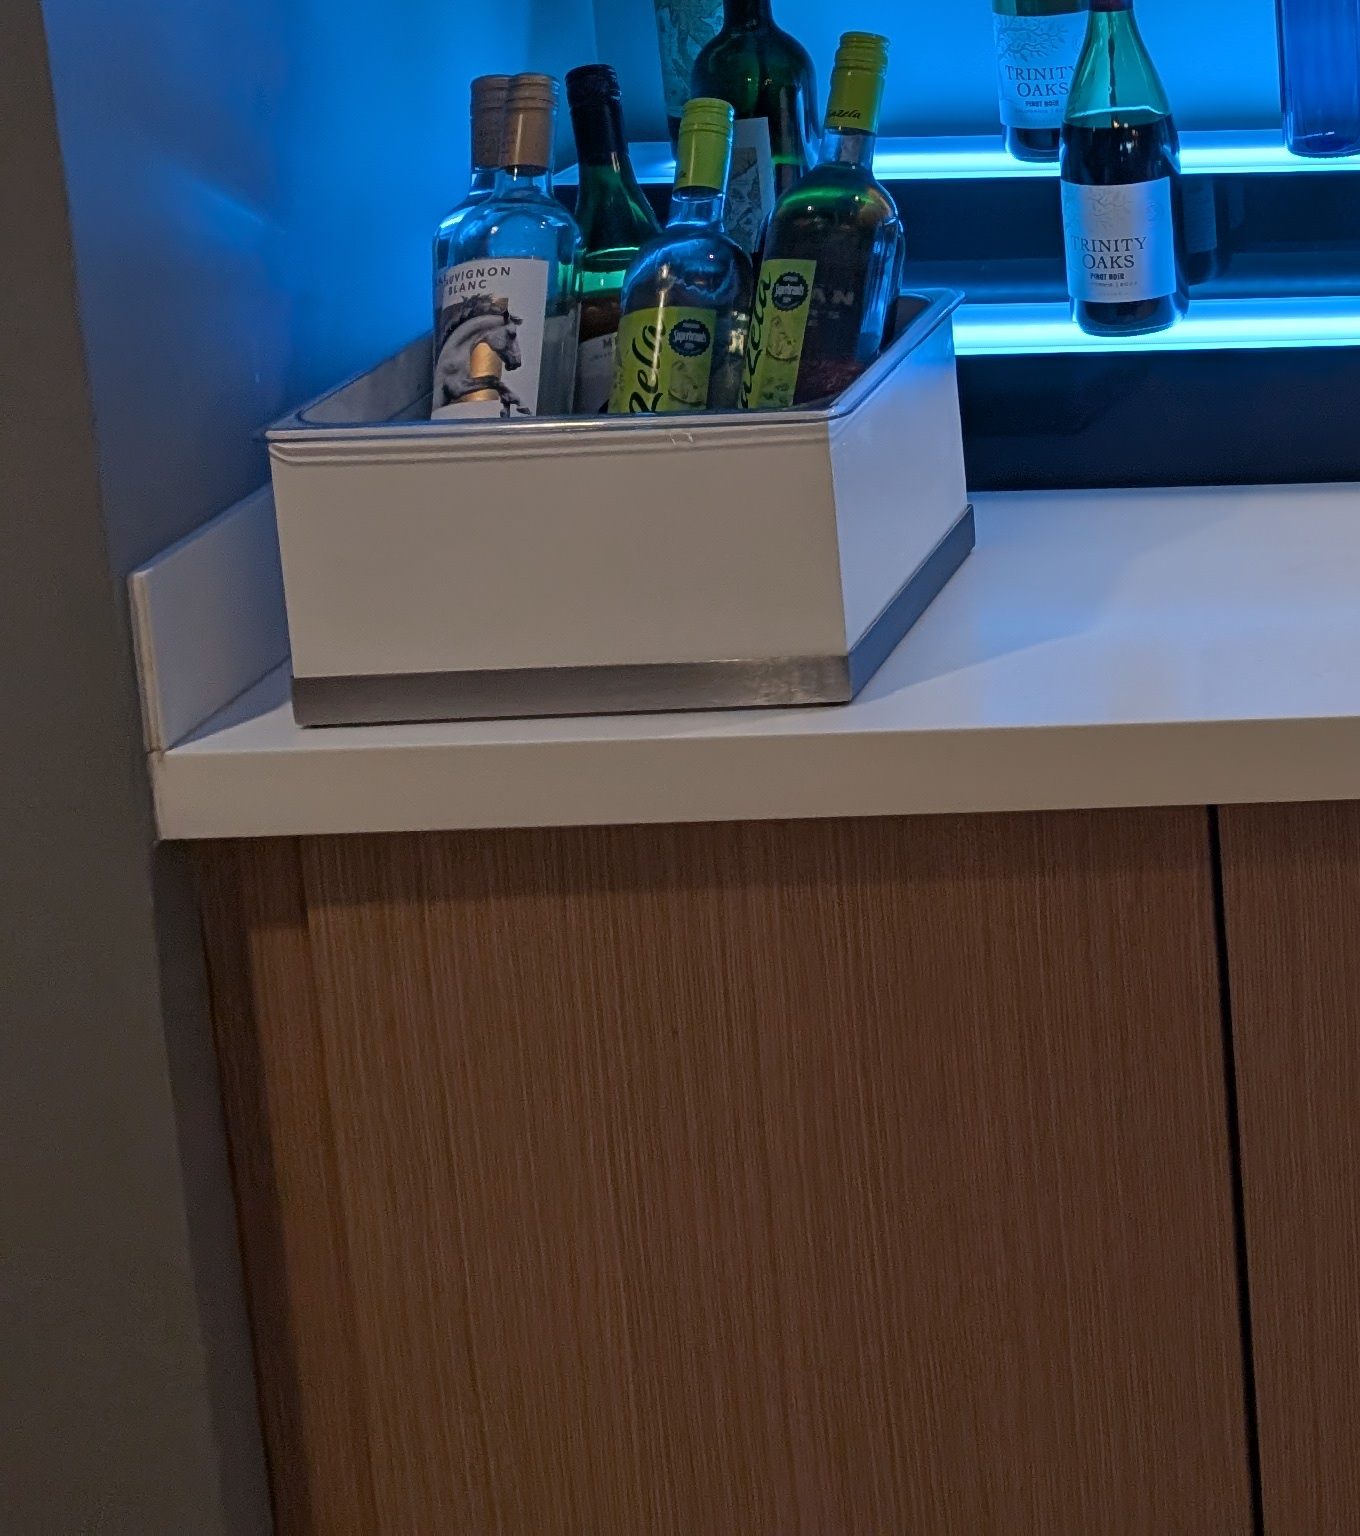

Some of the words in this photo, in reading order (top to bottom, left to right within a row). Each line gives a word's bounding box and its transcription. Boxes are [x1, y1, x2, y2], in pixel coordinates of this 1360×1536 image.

[1016, 82, 1069, 97] OAKS
[1070, 234, 1147, 253] TRINITY
[1082, 253, 1135, 270] OAKS
[448, 279, 487, 296] BLANC
